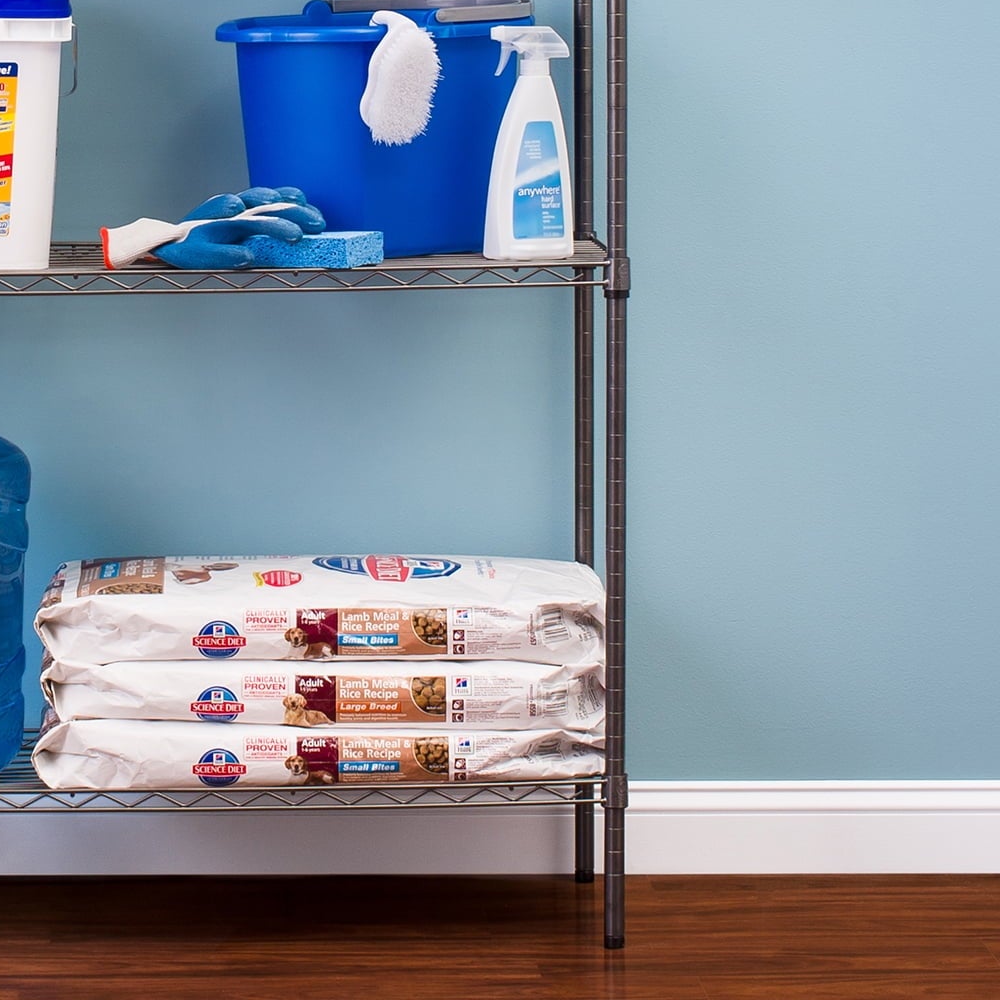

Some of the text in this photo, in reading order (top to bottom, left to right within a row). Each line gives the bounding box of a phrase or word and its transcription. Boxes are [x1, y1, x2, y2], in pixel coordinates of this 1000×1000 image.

[518, 185, 560, 197] anywhere
[301, 611, 326, 620] Adult
[342, 611, 409, 621] Lamb Meal &
[342, 622, 400, 632] Rice Recipe
[194, 637, 245, 646] SCIENCE DIET
[342, 636, 394, 644] Small Bites
[300, 679, 324, 687] Adult
[340, 679, 369, 688] Lamb
[372, 679, 398, 688] Meal
[340, 689, 399, 700] Rice Recipe
[192, 703, 243, 712] SCIENCE DIET
[340, 703, 367, 711] Large
[302, 739, 326, 747] Adult
[343, 739, 411, 748] Lamb Meal &
[343, 750, 401, 760] Rice Recipe
[194, 765, 245, 774] SCIENCE DIET
[343, 763, 396, 771] Small Bites
